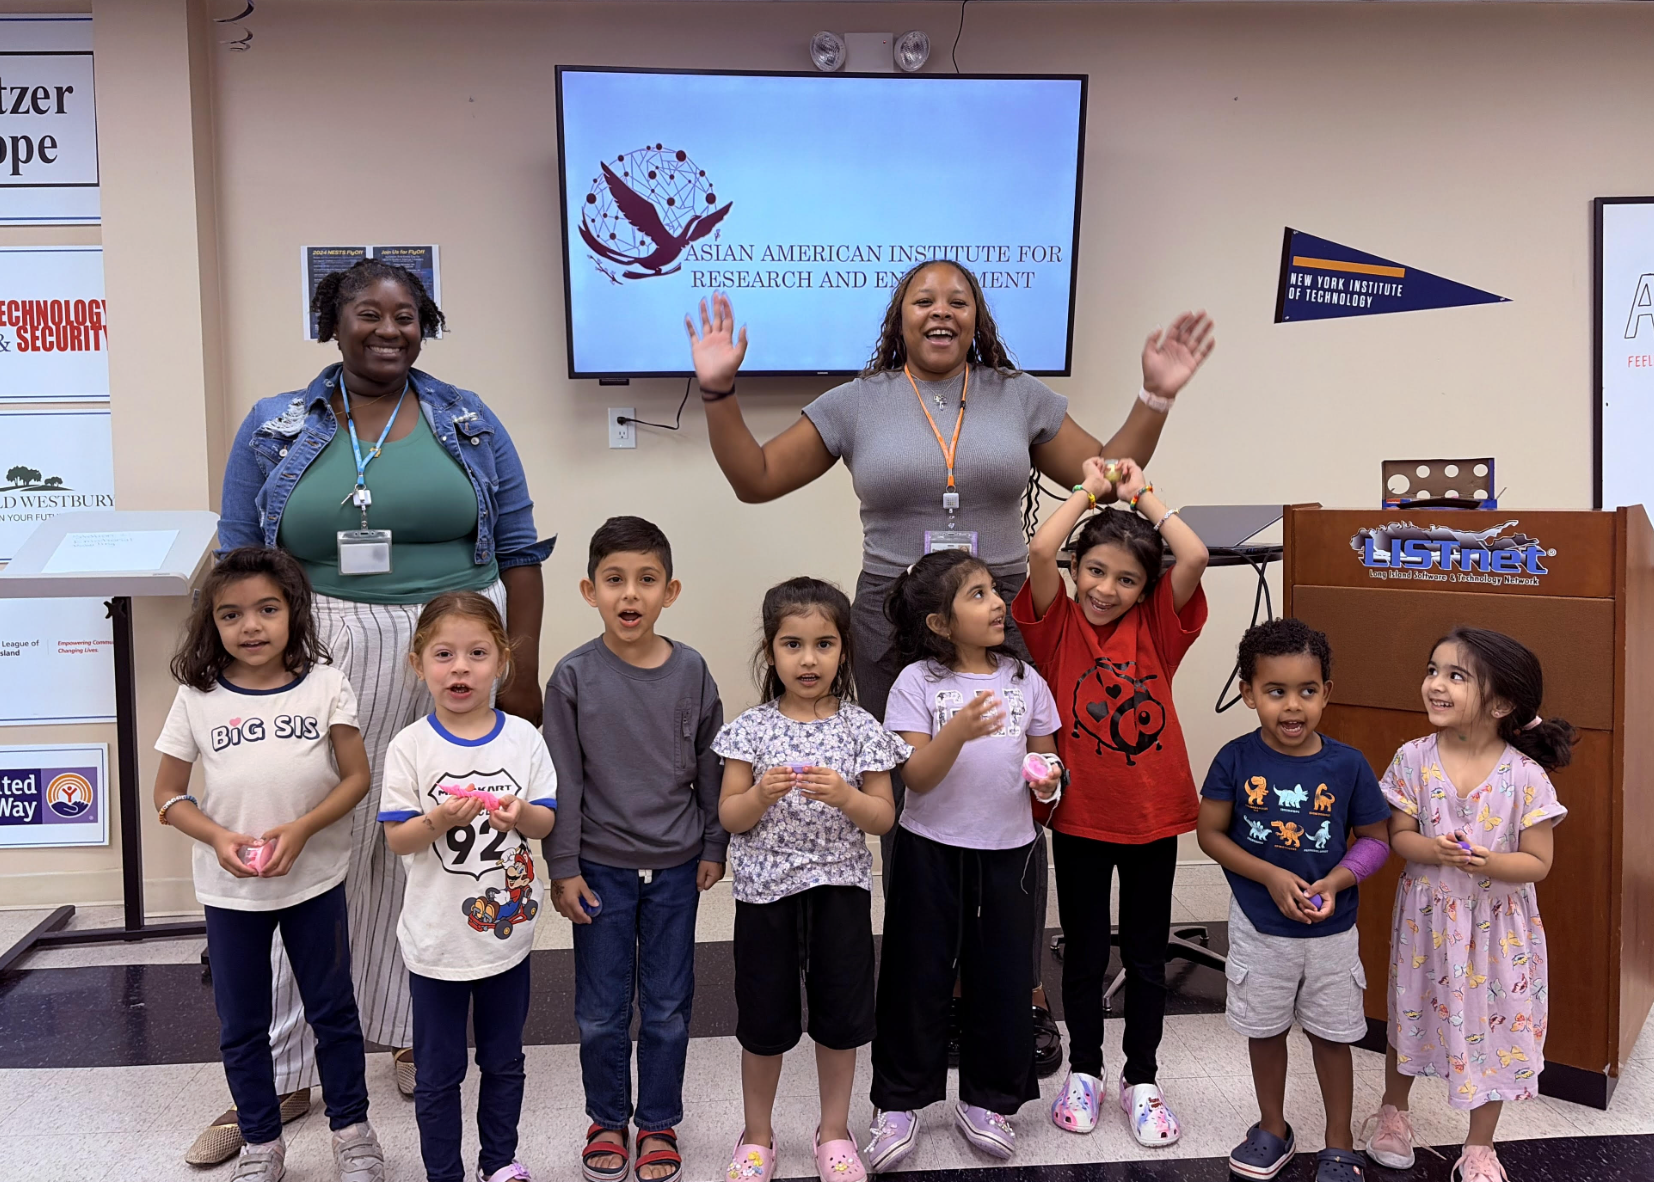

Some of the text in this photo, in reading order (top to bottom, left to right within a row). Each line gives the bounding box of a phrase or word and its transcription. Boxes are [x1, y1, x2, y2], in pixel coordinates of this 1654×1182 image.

[684, 244, 1063, 263] ASIAN AMERICAN INSTITUTE FOR
[690, 270, 813, 288] RESEARCH
[818, 271, 867, 289] AND
[1290, 272, 1403, 297] NEW YORK INSTITUTE
[1288, 287, 1373, 308] OF TECHNOLOGY
[20, 494, 115, 508] WESTBURY
[7, 514, 33, 522] YOUR
[1359, 538, 1548, 574] LISTnet
[1369, 569, 1540, 586] Long Island Software & Technology Network
[2, 639, 39, 649] League of
[274, 715, 320, 740] SIS
[0, 774, 37, 795] ted
[0, 798, 37, 822] Way
[446, 819, 507, 865] 92
